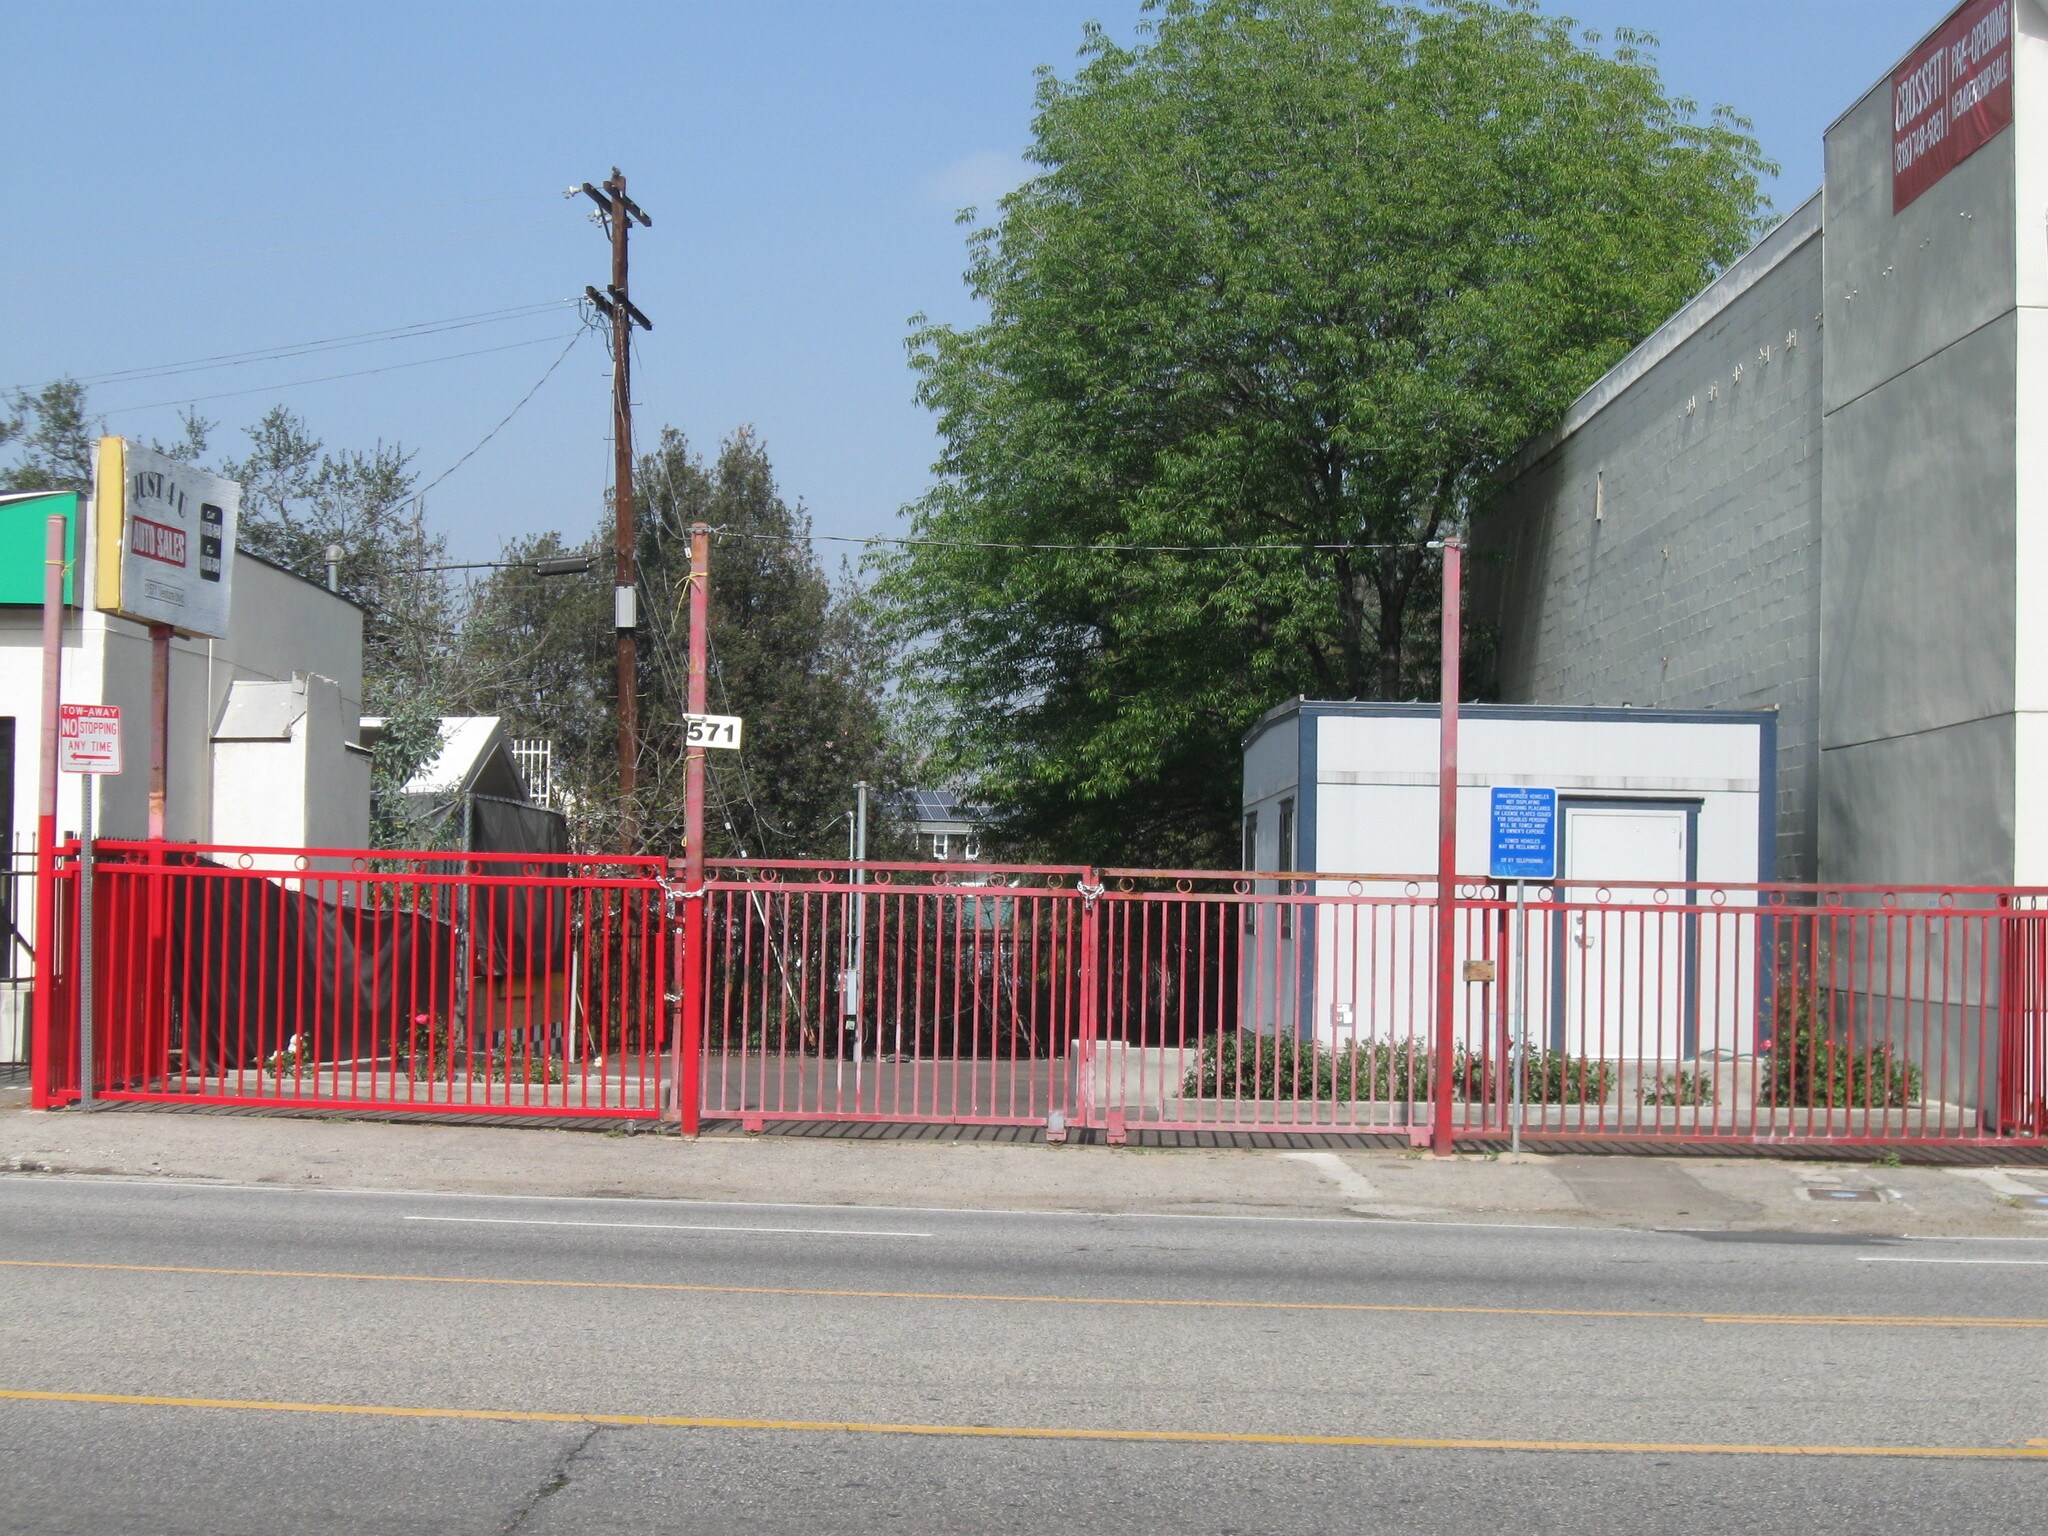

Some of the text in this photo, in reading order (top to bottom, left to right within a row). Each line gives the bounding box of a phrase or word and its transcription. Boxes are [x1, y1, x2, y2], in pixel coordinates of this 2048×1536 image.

[1952, 0, 2007, 82] PRE-OPENING
[1895, 47, 1944, 131] CROSSFIT
[1991, 50, 2008, 90] SALE
[133, 470, 188, 518] JUST 4 U
[132, 520, 155, 555] AUTO
[157, 527, 185, 563] SALES
[61, 706, 118, 717] TOW-AWAY
[62, 718, 117, 736] NO STOPPING
[68, 740, 113, 752] ANY TIME
[687, 722, 734, 742] 571
